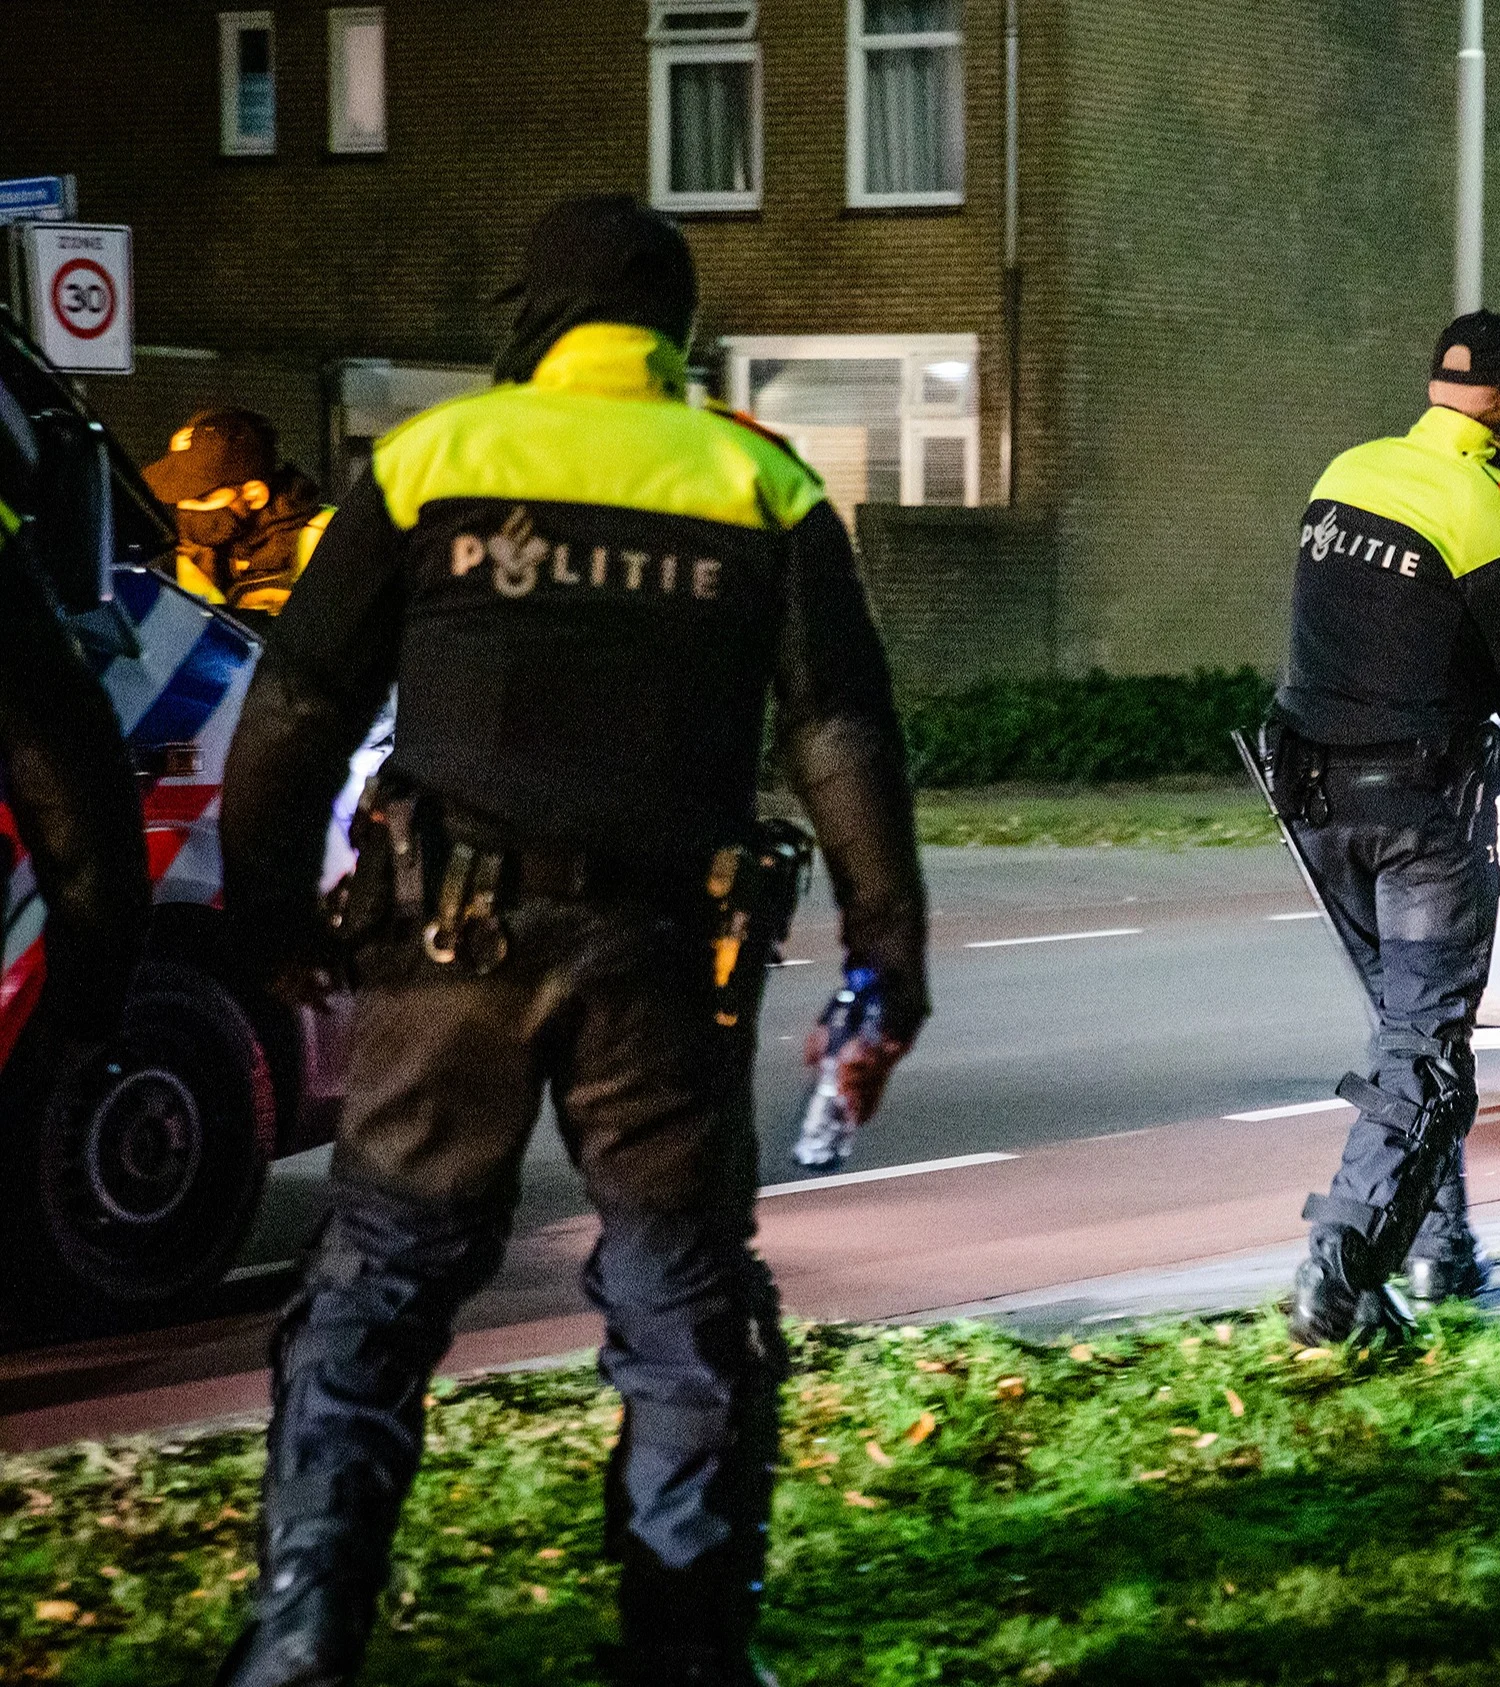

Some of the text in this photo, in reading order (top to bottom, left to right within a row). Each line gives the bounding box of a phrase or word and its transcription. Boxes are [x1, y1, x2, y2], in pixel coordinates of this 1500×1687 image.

[63, 284, 107, 313] 30
[450, 504, 722, 599] POLITIE
[1300, 505, 1421, 578] POLITIE
